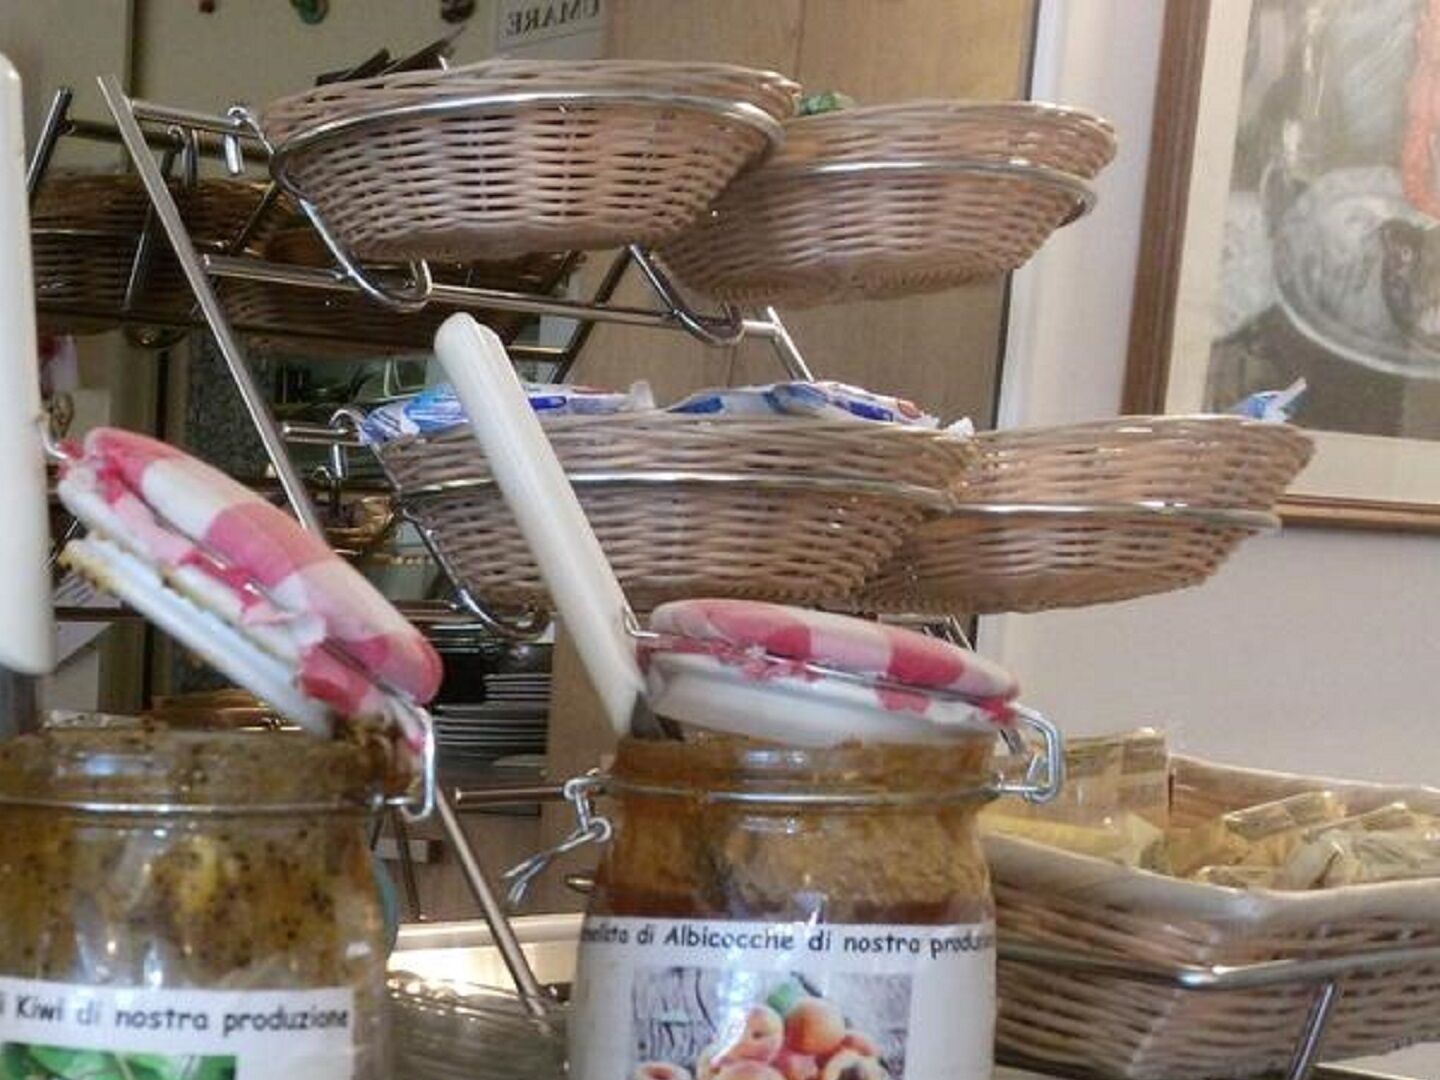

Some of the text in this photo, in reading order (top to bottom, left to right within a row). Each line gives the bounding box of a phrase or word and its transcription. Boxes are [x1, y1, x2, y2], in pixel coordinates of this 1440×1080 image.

[637, 924, 655, 944] di
[663, 926, 795, 951] Albicocche
[808, 928, 831, 951] di
[844, 933, 921, 955] nostra
[16, 994, 64, 1022] Kiwi
[76, 997, 101, 1027] di
[115, 1007, 208, 1031] nostra
[221, 1004, 349, 1037] produzione
